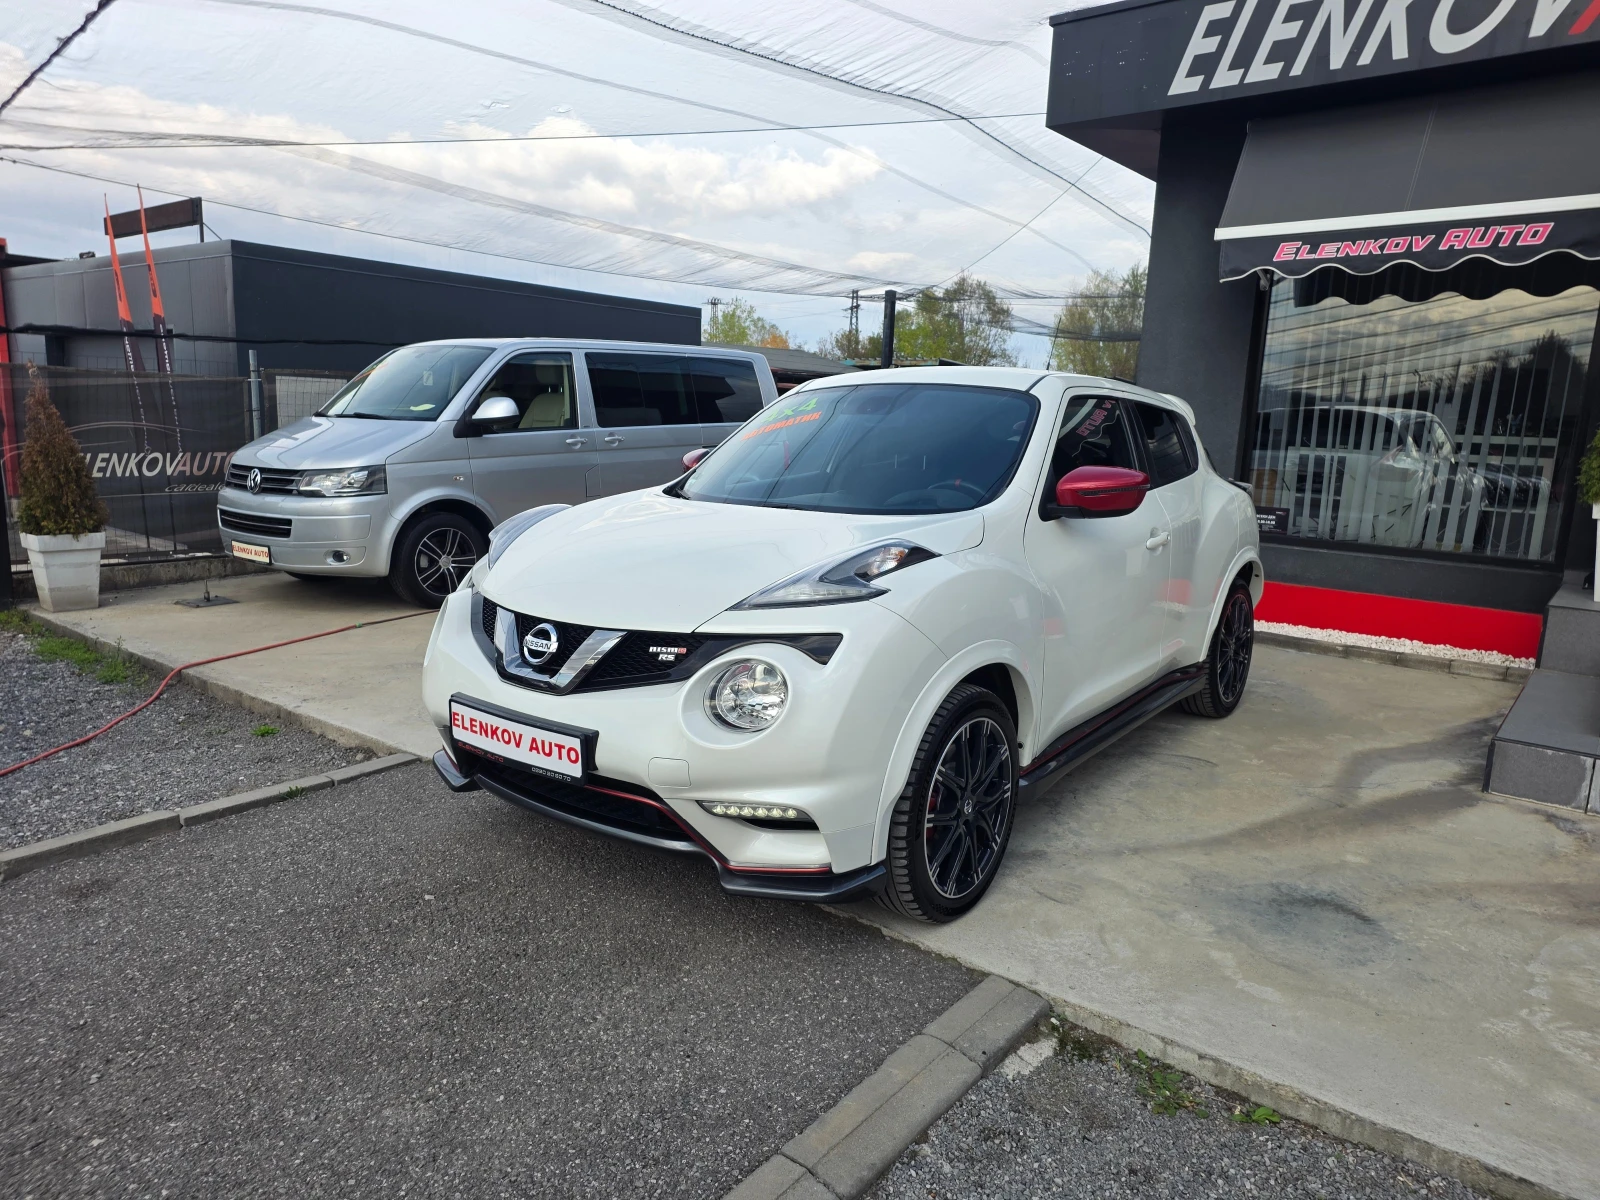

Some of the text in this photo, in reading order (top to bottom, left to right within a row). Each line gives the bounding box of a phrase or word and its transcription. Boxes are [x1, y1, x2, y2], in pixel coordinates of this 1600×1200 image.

[1439, 222, 1555, 250] AUTO
[80, 451, 236, 477] ENKOVAUT
[254, 549, 269, 558] AUTO
[523, 638, 552, 650] NISSAN
[658, 653, 676, 661] RS
[452, 711, 580, 764] ELENKOV AUTO
